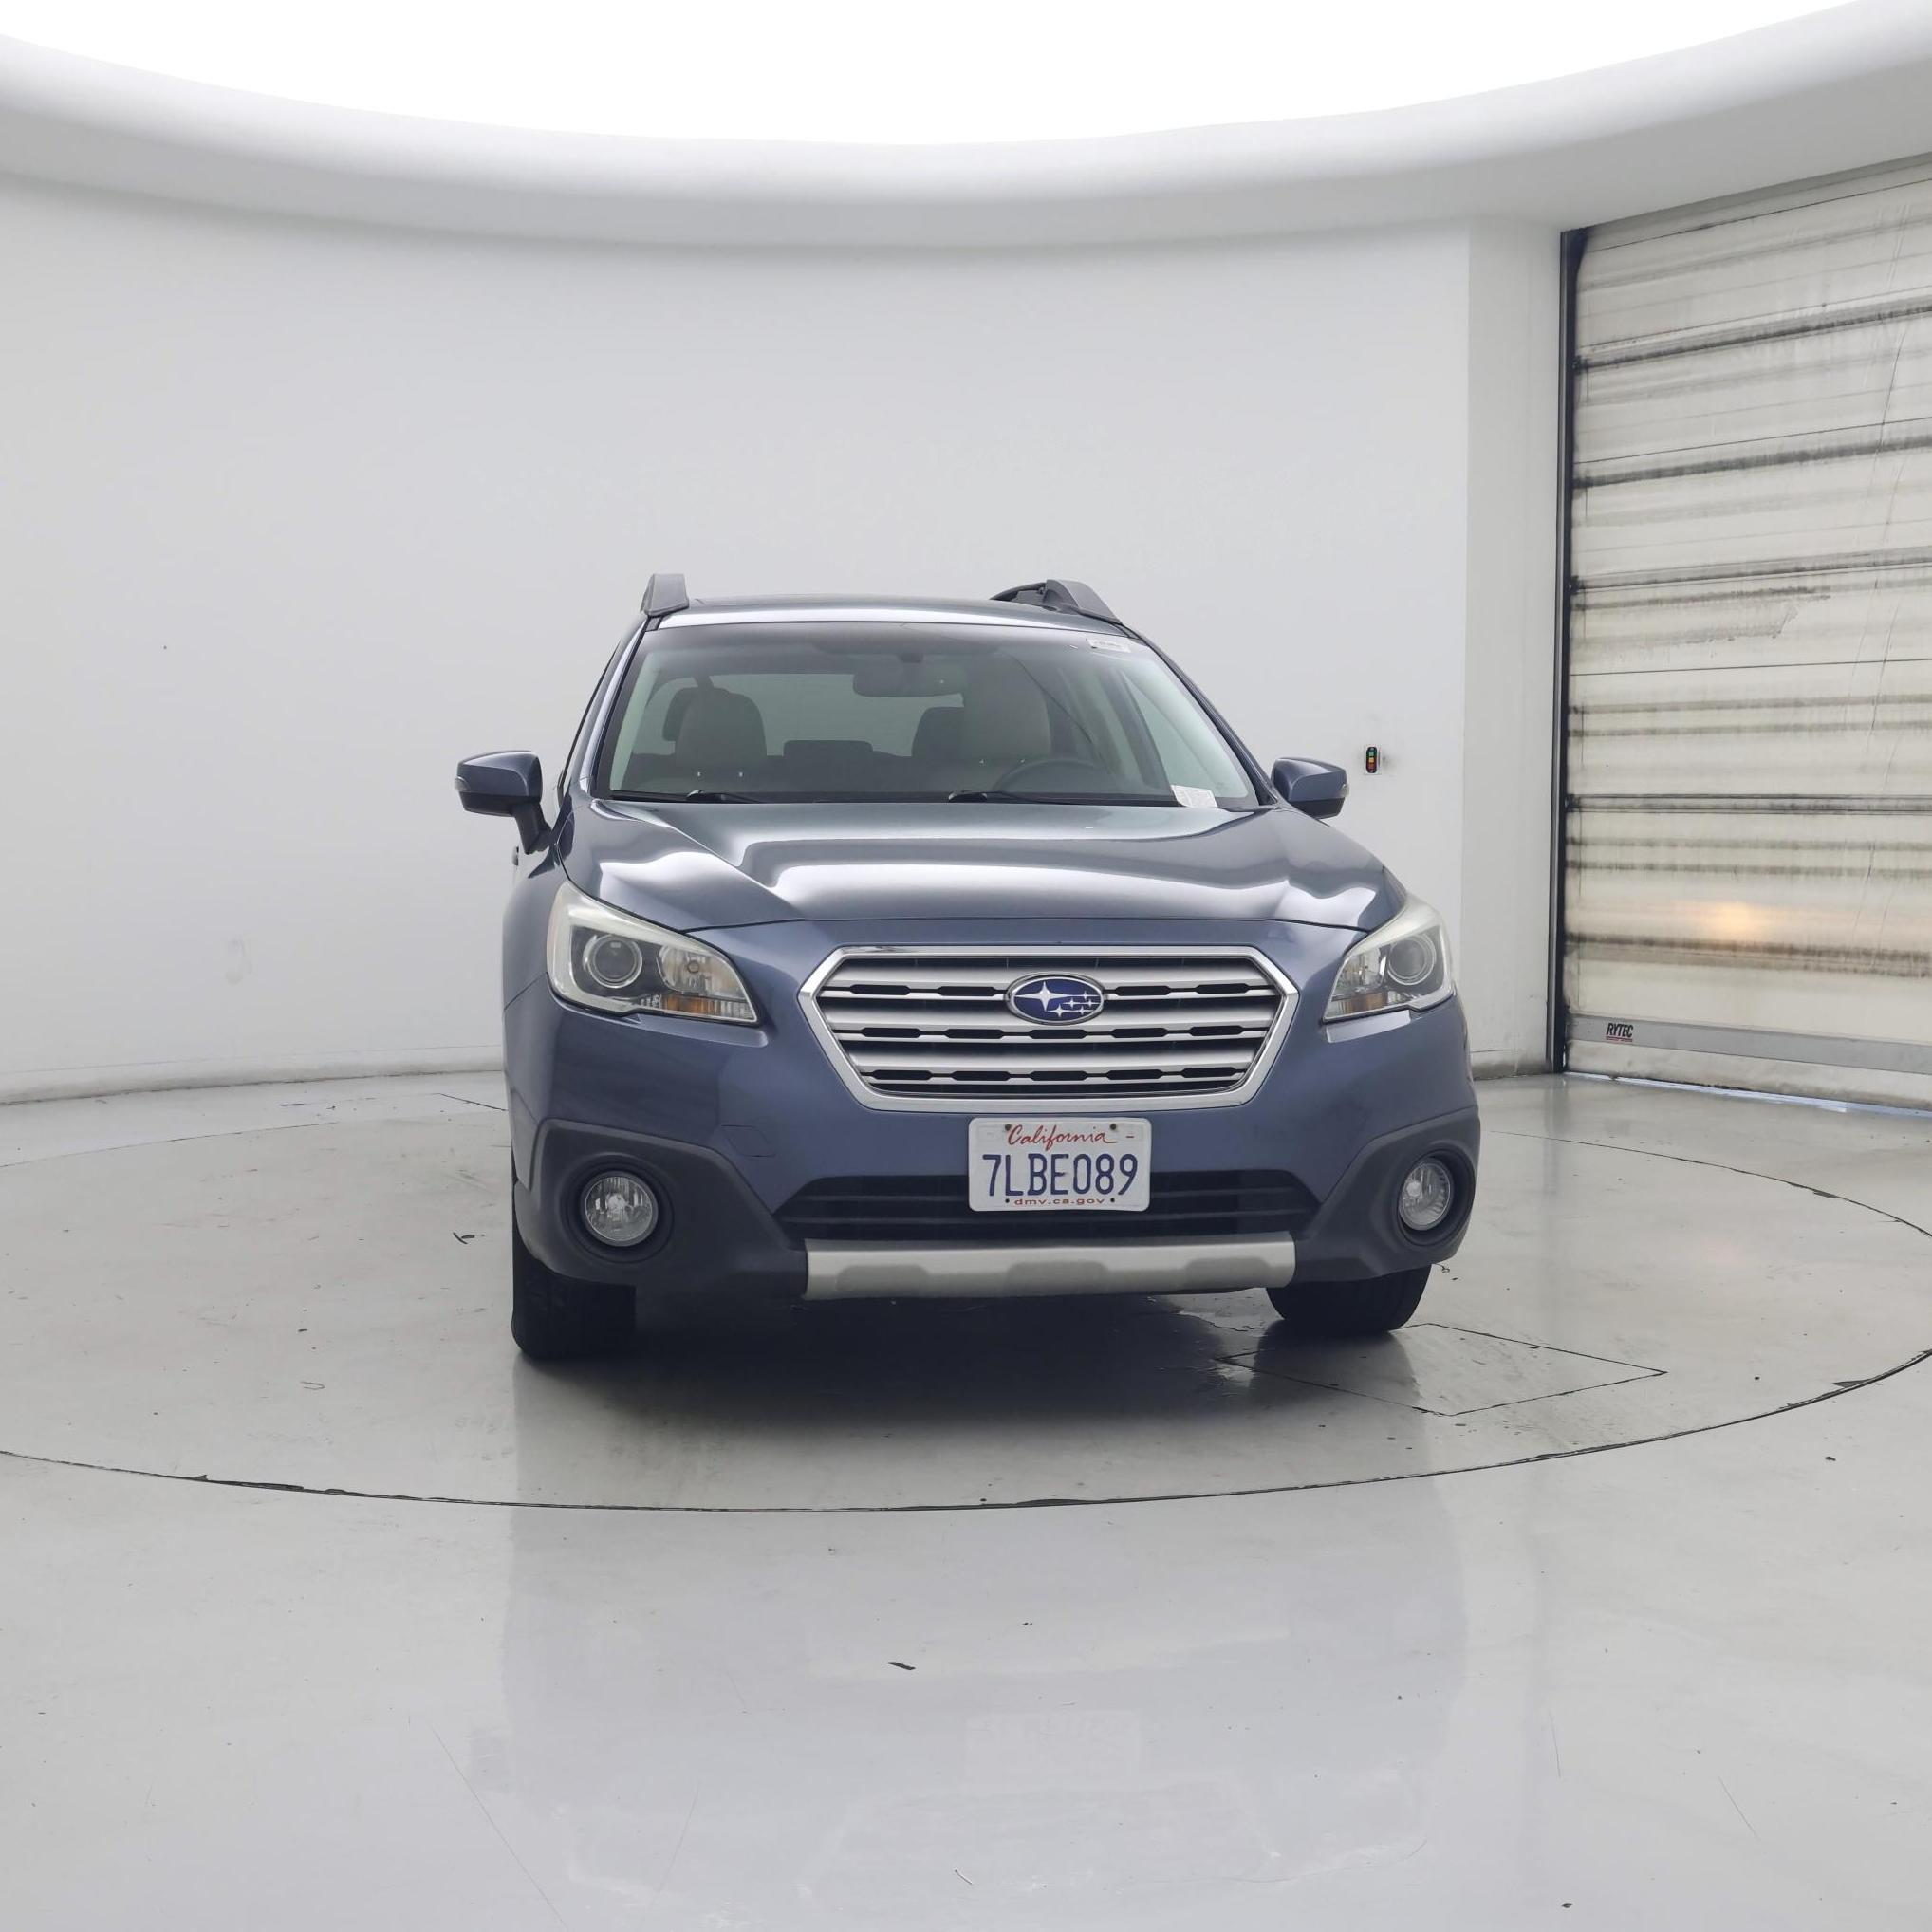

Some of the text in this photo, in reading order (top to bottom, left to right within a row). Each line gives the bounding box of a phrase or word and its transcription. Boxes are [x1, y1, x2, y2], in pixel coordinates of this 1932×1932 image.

[1606, 1022, 1634, 1038] RYTEC
[1007, 1124, 1118, 1152] California
[982, 1153, 1139, 1197] 7LBE089
[1013, 1198, 1105, 1206] dmv.ca.gov
